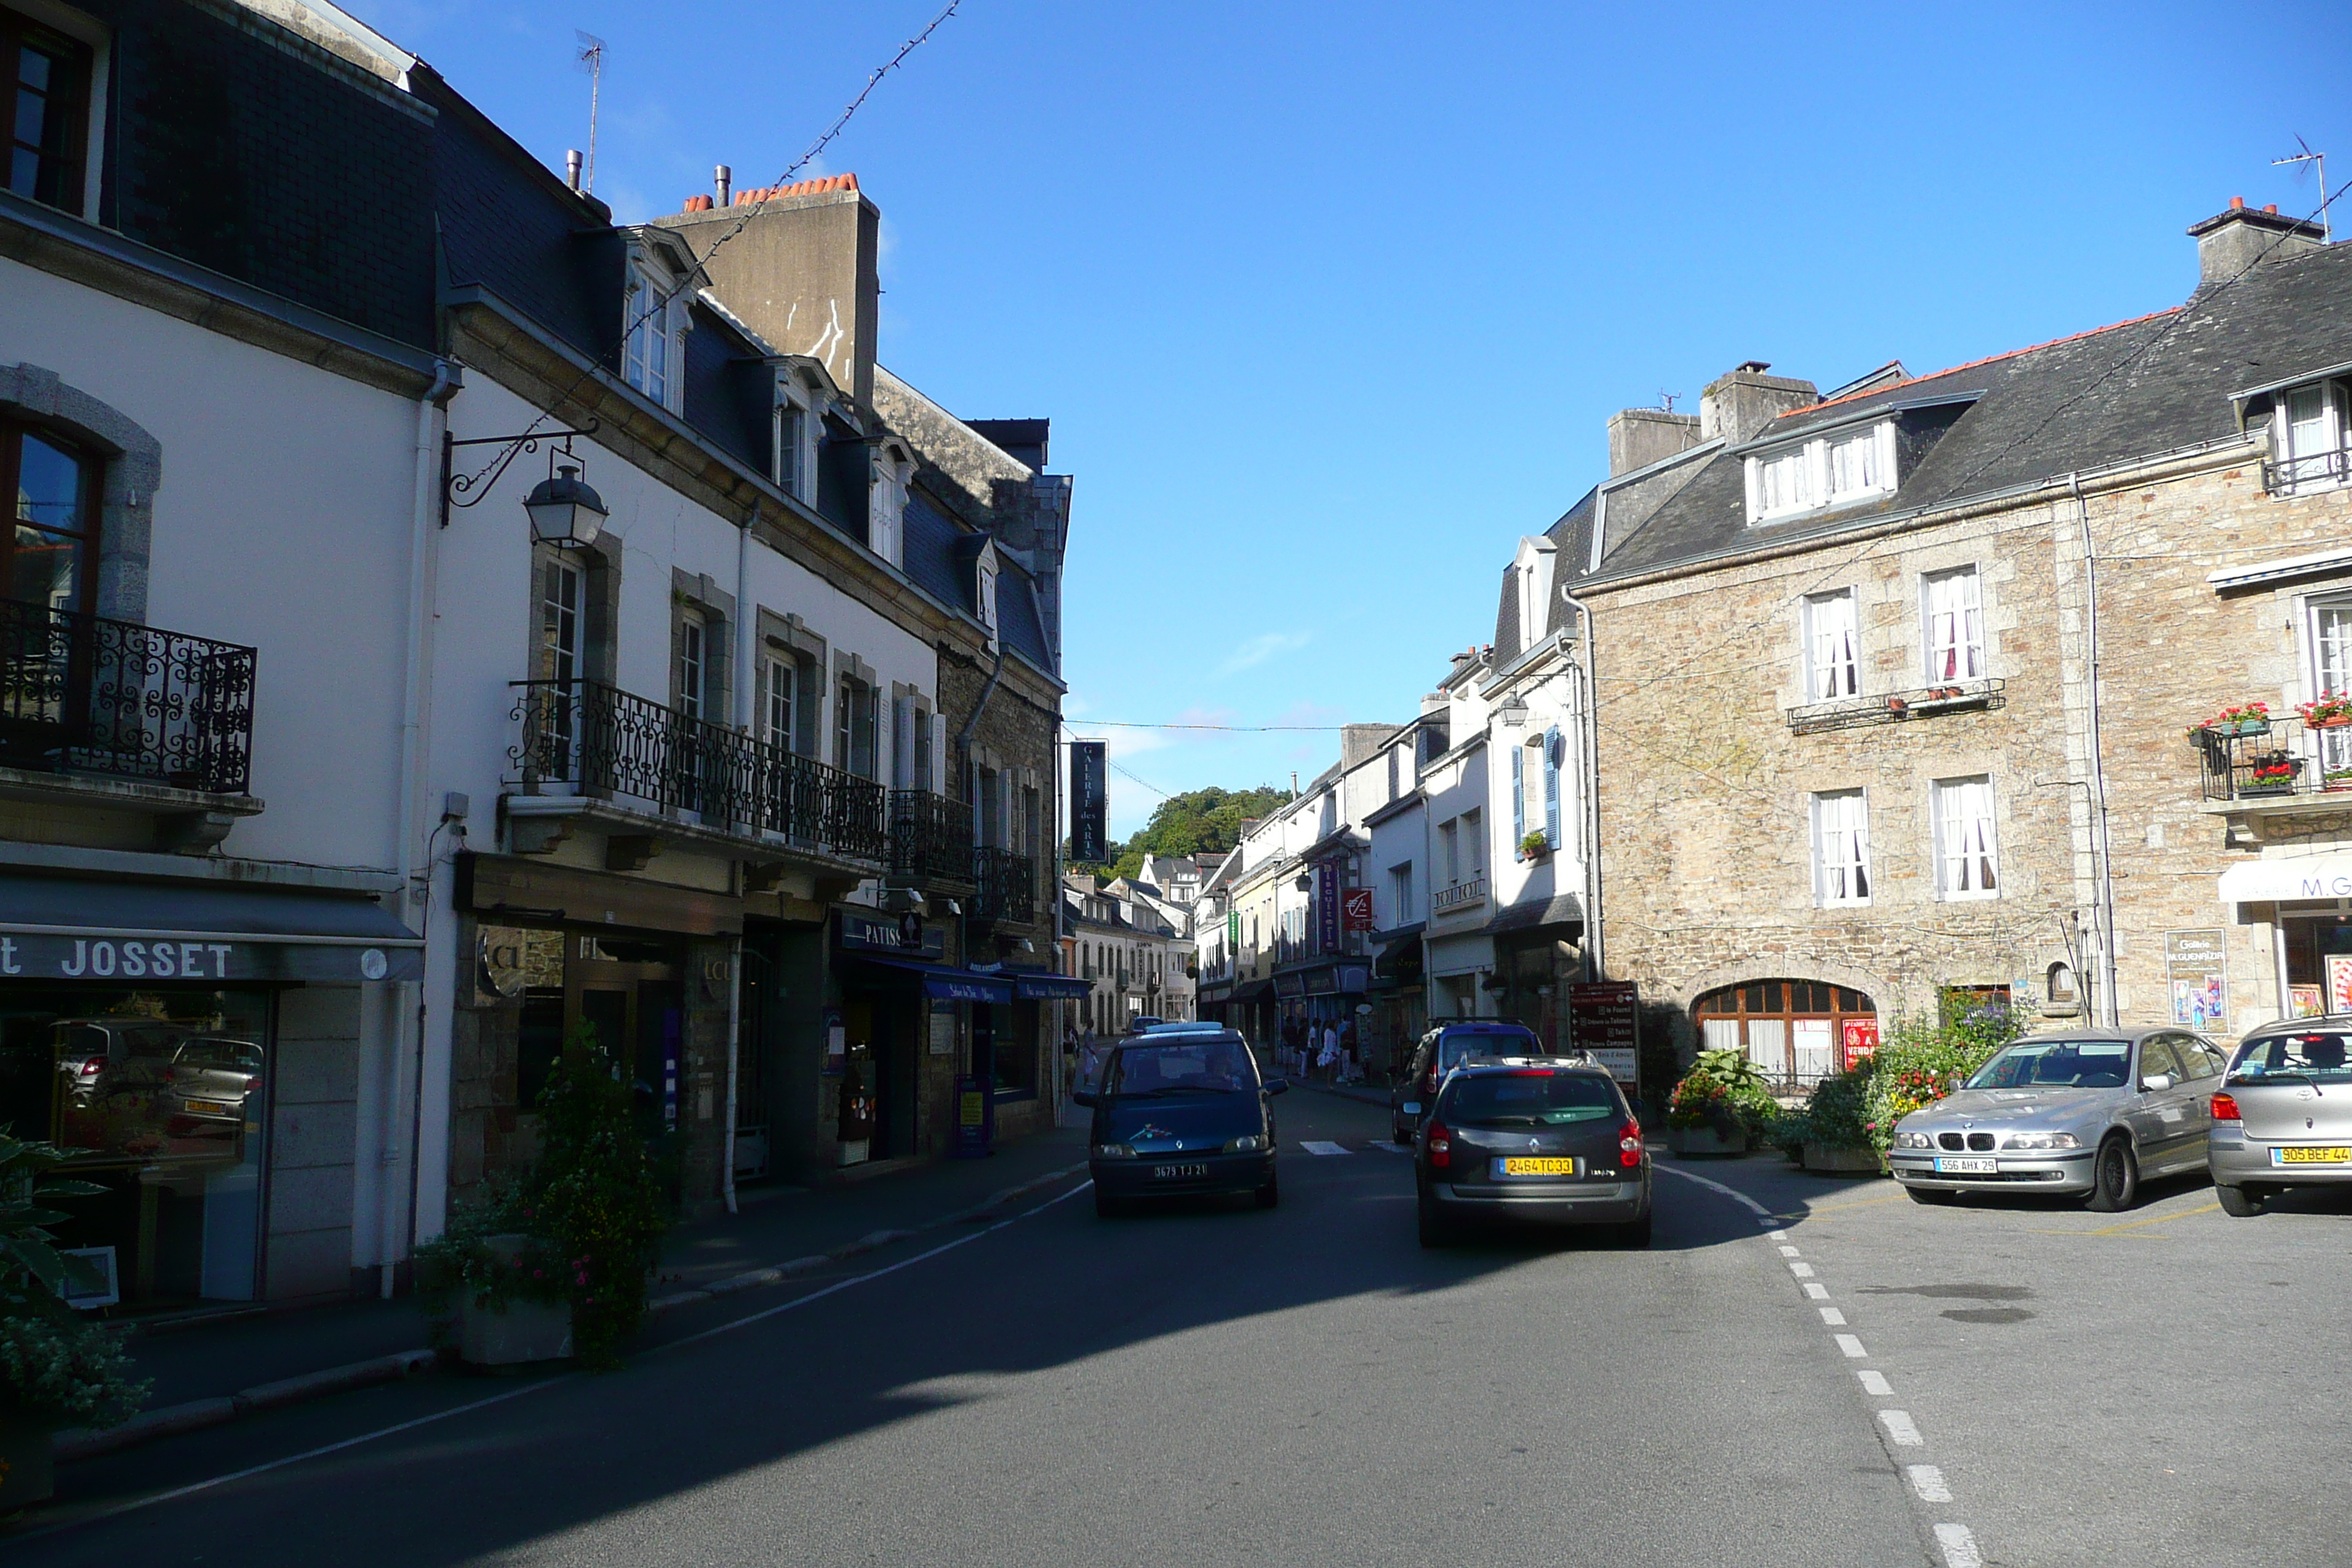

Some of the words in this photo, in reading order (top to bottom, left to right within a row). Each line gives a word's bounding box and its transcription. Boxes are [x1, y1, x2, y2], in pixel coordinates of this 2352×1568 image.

[1084, 745, 1093, 808] GALERIE
[1081, 811, 1096, 819] des
[1085, 822, 1093, 859] ARTS
[2241, 886, 2291, 898] GALERIE
[1324, 864, 1333, 948] Biscuiterie
[2179, 940, 2210, 950] Galerie
[61, 940, 232, 978] JOSSET
[1866, 1036, 1872, 1046] A
[1847, 1047, 1876, 1056] VENDR
[2283, 1149, 2305, 1160] 905
[2310, 1148, 2330, 1160] BEF
[2334, 1149, 2348, 1160] 44
[1509, 1160, 1538, 1172] 2464
[1557, 1160, 1570, 1172] 33
[1942, 1160, 1959, 1170] 556
[1962, 1161, 1979, 1171] AHX
[1983, 1161, 1994, 1171] 29
